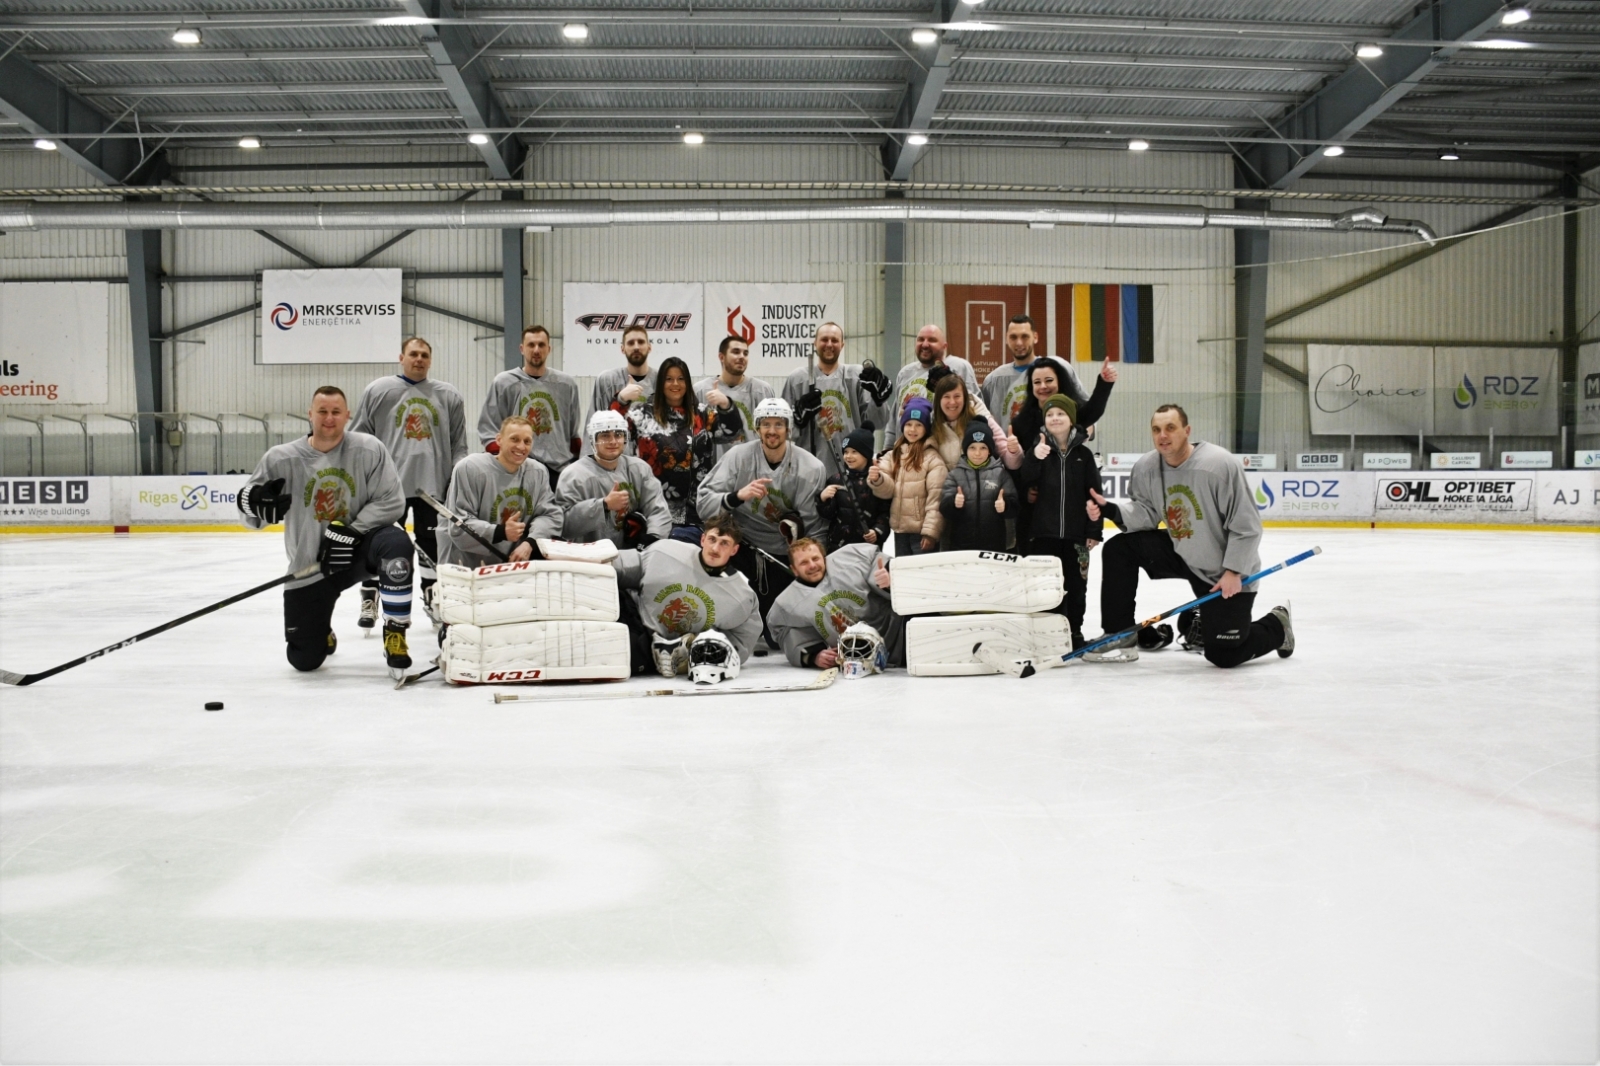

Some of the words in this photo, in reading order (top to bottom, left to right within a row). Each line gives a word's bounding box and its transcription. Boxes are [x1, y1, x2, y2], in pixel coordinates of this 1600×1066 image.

[302, 304, 396, 316] MRKSERVISS
[762, 304, 826, 319] INDUSTRY
[575, 313, 692, 331] FALCONS
[762, 324, 816, 338] SERVICE
[0, 359, 20, 376] ls
[0, 380, 58, 400] eering
[1314, 363, 1427, 413] Choice
[1483, 376, 1539, 395] RDZ
[1483, 401, 1539, 409] ENERGY
[1302, 455, 1338, 463] MESH
[1282, 480, 1339, 497] RDZ
[1444, 481, 1516, 493] OPTIBET
[139, 490, 178, 505] Rīgas
[211, 491, 238, 503] Ene
[1553, 489, 1580, 505] AJ
[51, 508, 90, 516] buildings
[1282, 502, 1339, 510] ENERGY
[978, 551, 1018, 563] CCM
[478, 561, 530, 576] CCM
[486, 669, 542, 681] CCM
